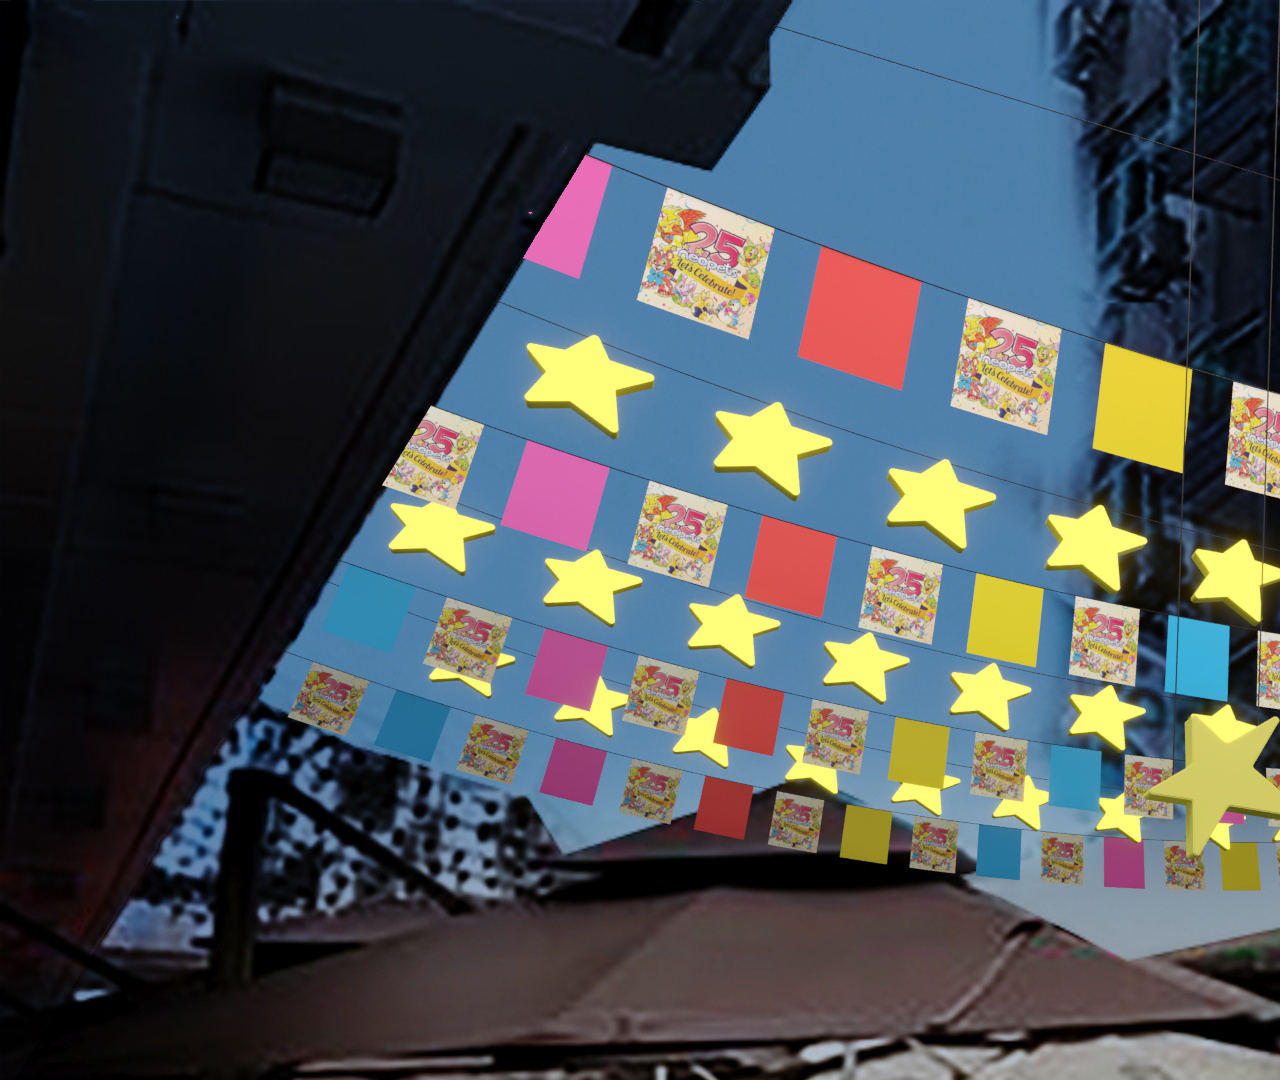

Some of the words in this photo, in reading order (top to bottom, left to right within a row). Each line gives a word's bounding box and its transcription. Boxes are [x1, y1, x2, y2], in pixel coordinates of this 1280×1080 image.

[684, 221, 746, 268] 25
[677, 249, 738, 278] neopets
[676, 258, 694, 273] Let's
[693, 268, 736, 297] Celebrate!
[986, 328, 1039, 369] 25
[981, 355, 1034, 379] neopets
[996, 372, 1033, 396] Celebrate!
[409, 420, 460, 455] 25
[402, 450, 414, 459] et's
[661, 504, 707, 536] 25
[885, 566, 925, 596] 25
[454, 616, 494, 643] 25
[1090, 614, 1125, 641] 25
[317, 678, 352, 701] 25
[647, 672, 683, 697] 25
[823, 714, 855, 737] 25
[481, 730, 514, 751] 25
[987, 745, 1016, 767] 25
[640, 772, 669, 792] 25
[1137, 766, 1163, 787] 25
[786, 803, 813, 822] 25
[924, 826, 948, 845] 25
[1052, 841, 1074, 858] 25
